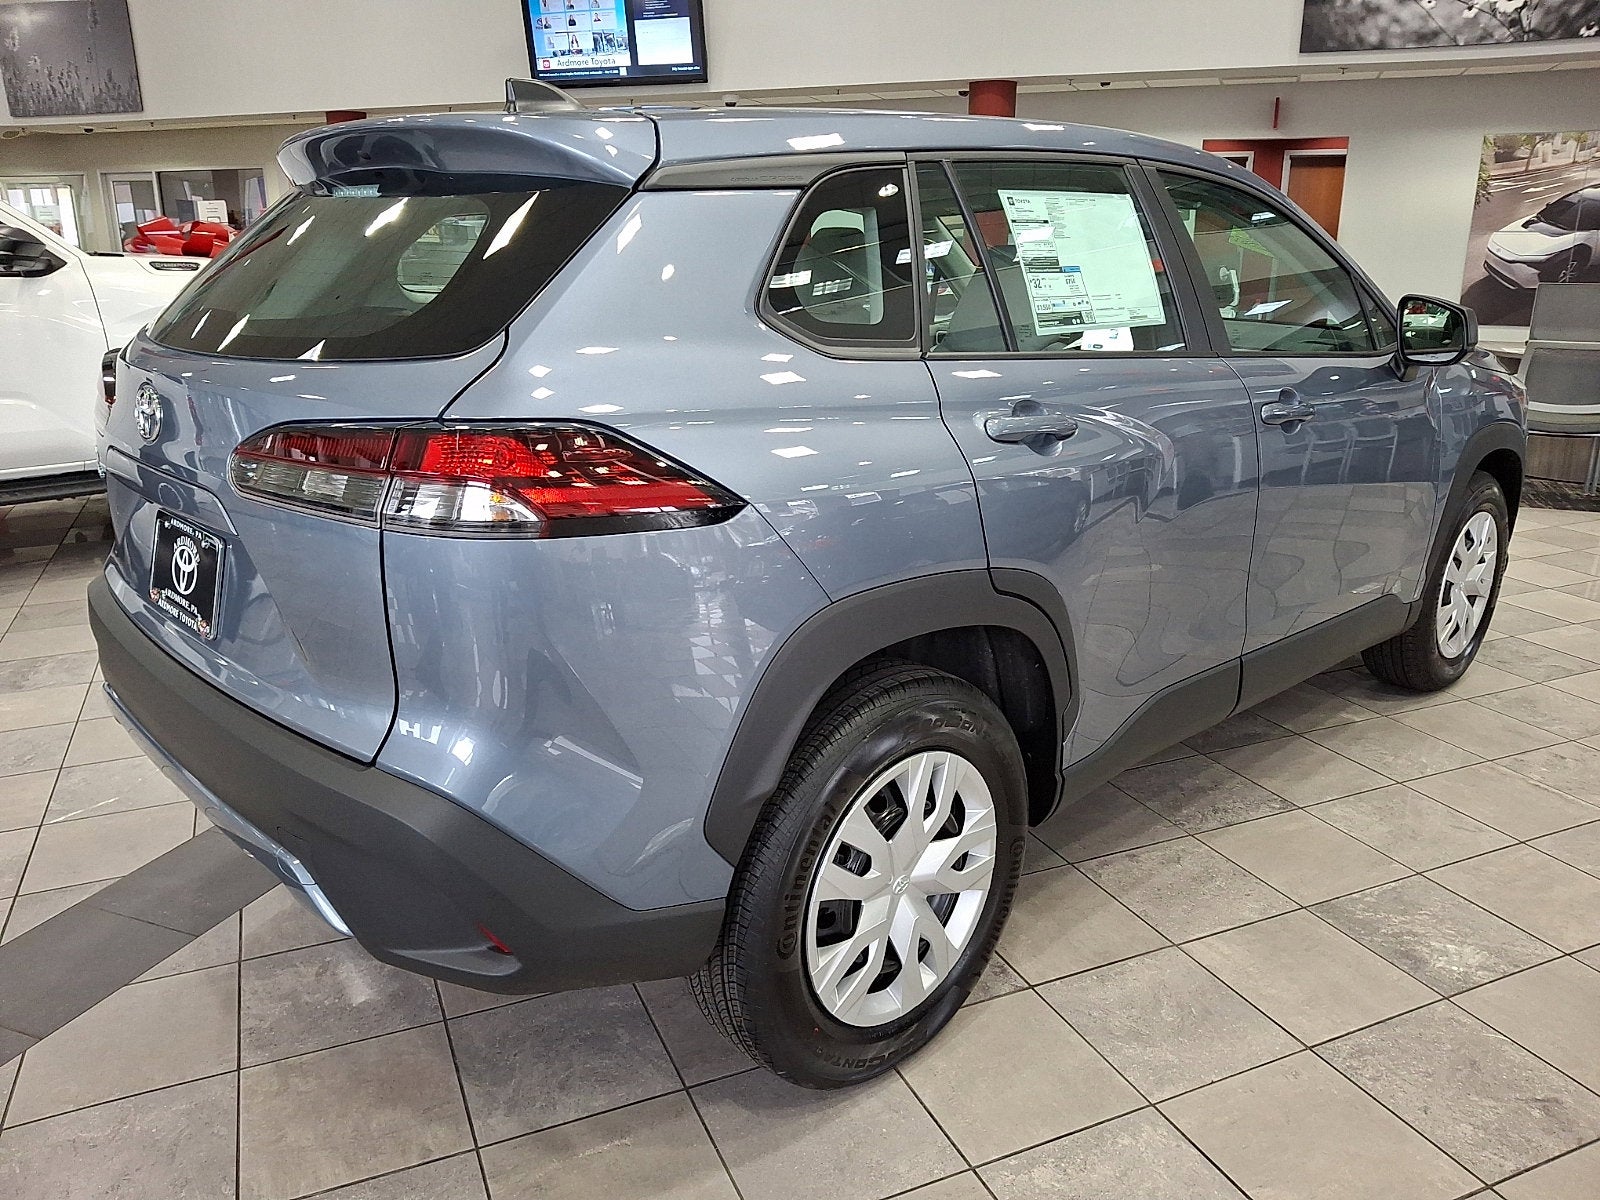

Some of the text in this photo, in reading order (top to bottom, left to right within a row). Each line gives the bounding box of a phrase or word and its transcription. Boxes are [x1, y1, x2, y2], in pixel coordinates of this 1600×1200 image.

[557, 57, 616, 67] Ardmore Toyota
[170, 518, 202, 539] ARDMORE, PA
[173, 535, 200, 566] ARDMORE
[157, 598, 199, 633] ARDMORE TOYOTA
[190, 604, 199, 616] PA
